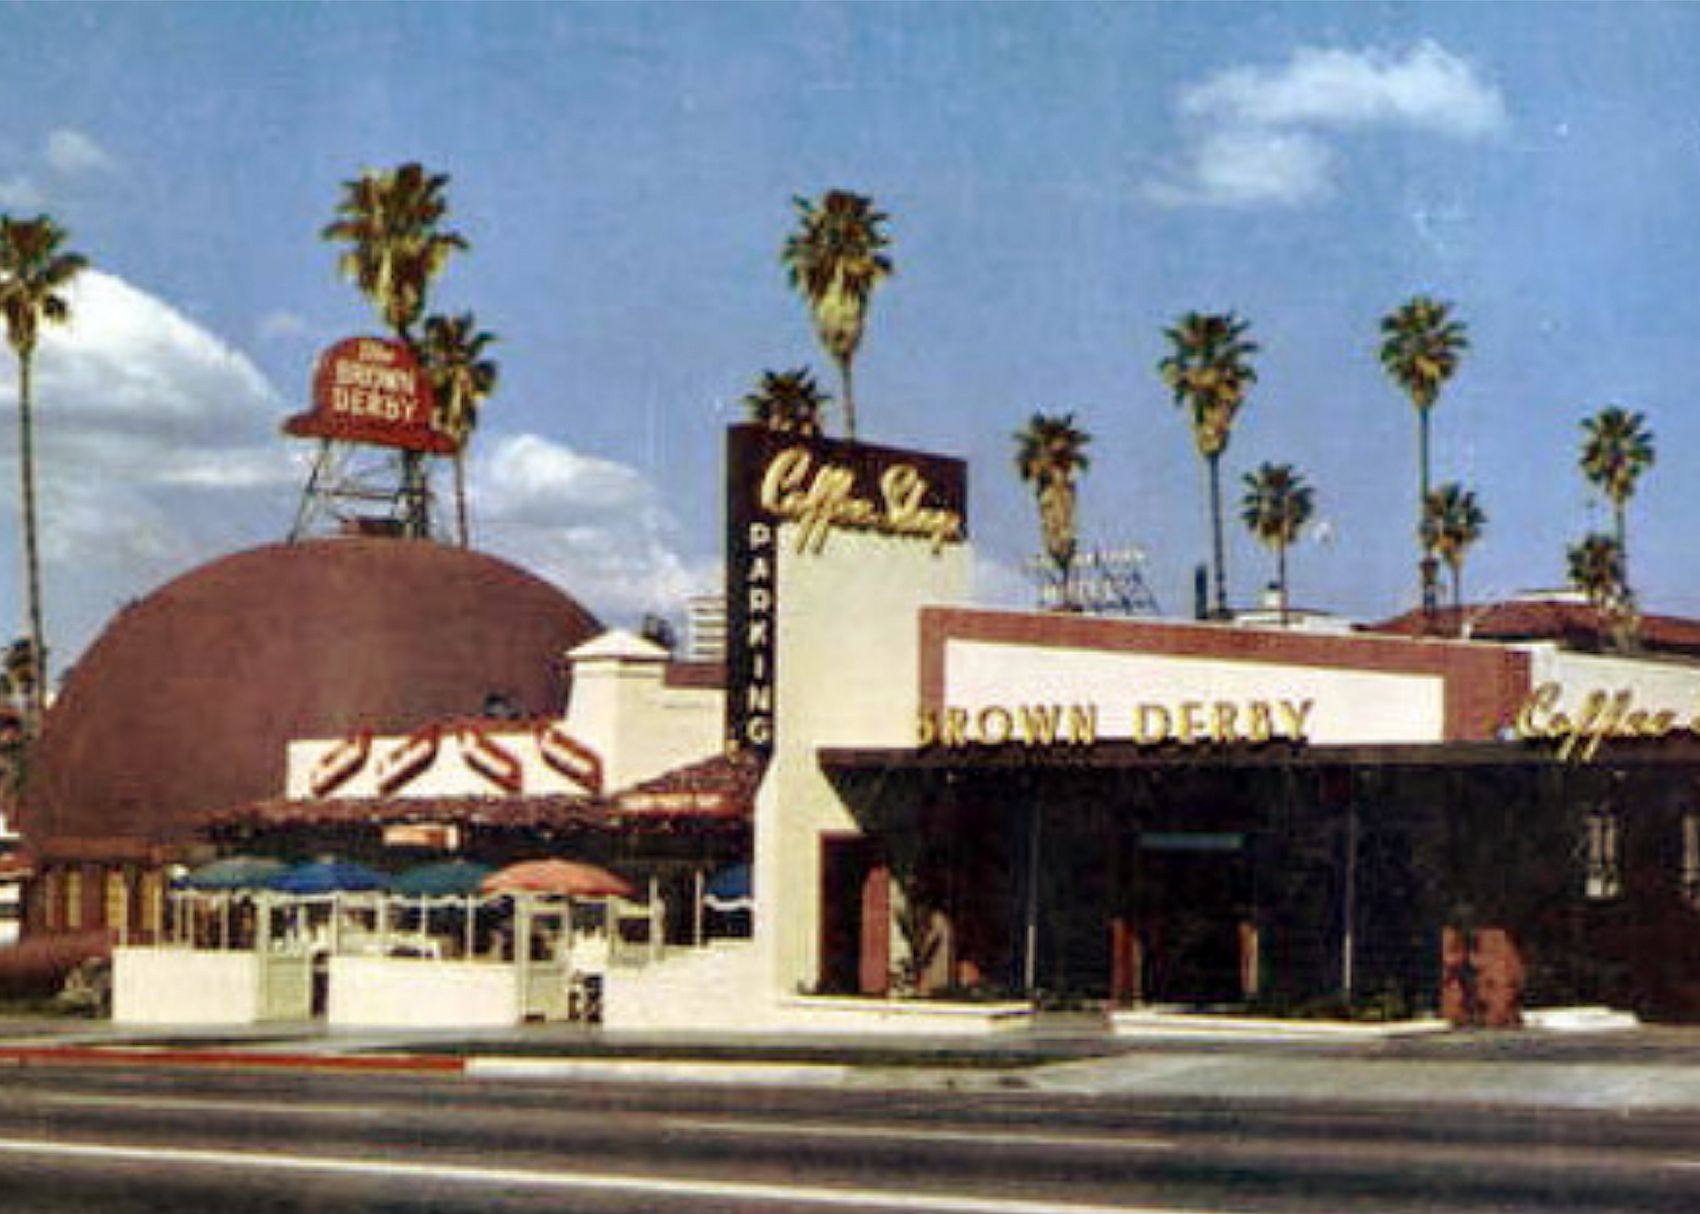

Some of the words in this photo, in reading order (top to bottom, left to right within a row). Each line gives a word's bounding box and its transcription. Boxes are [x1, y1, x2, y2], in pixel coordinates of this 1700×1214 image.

[335, 359, 415, 394] BROWN
[332, 386, 418, 421] DERBY
[748, 521, 772, 744] PARKING
[917, 703, 1098, 747] BROWN
[1131, 699, 1314, 746] DERBY
[1516, 681, 1676, 765] Coffee
